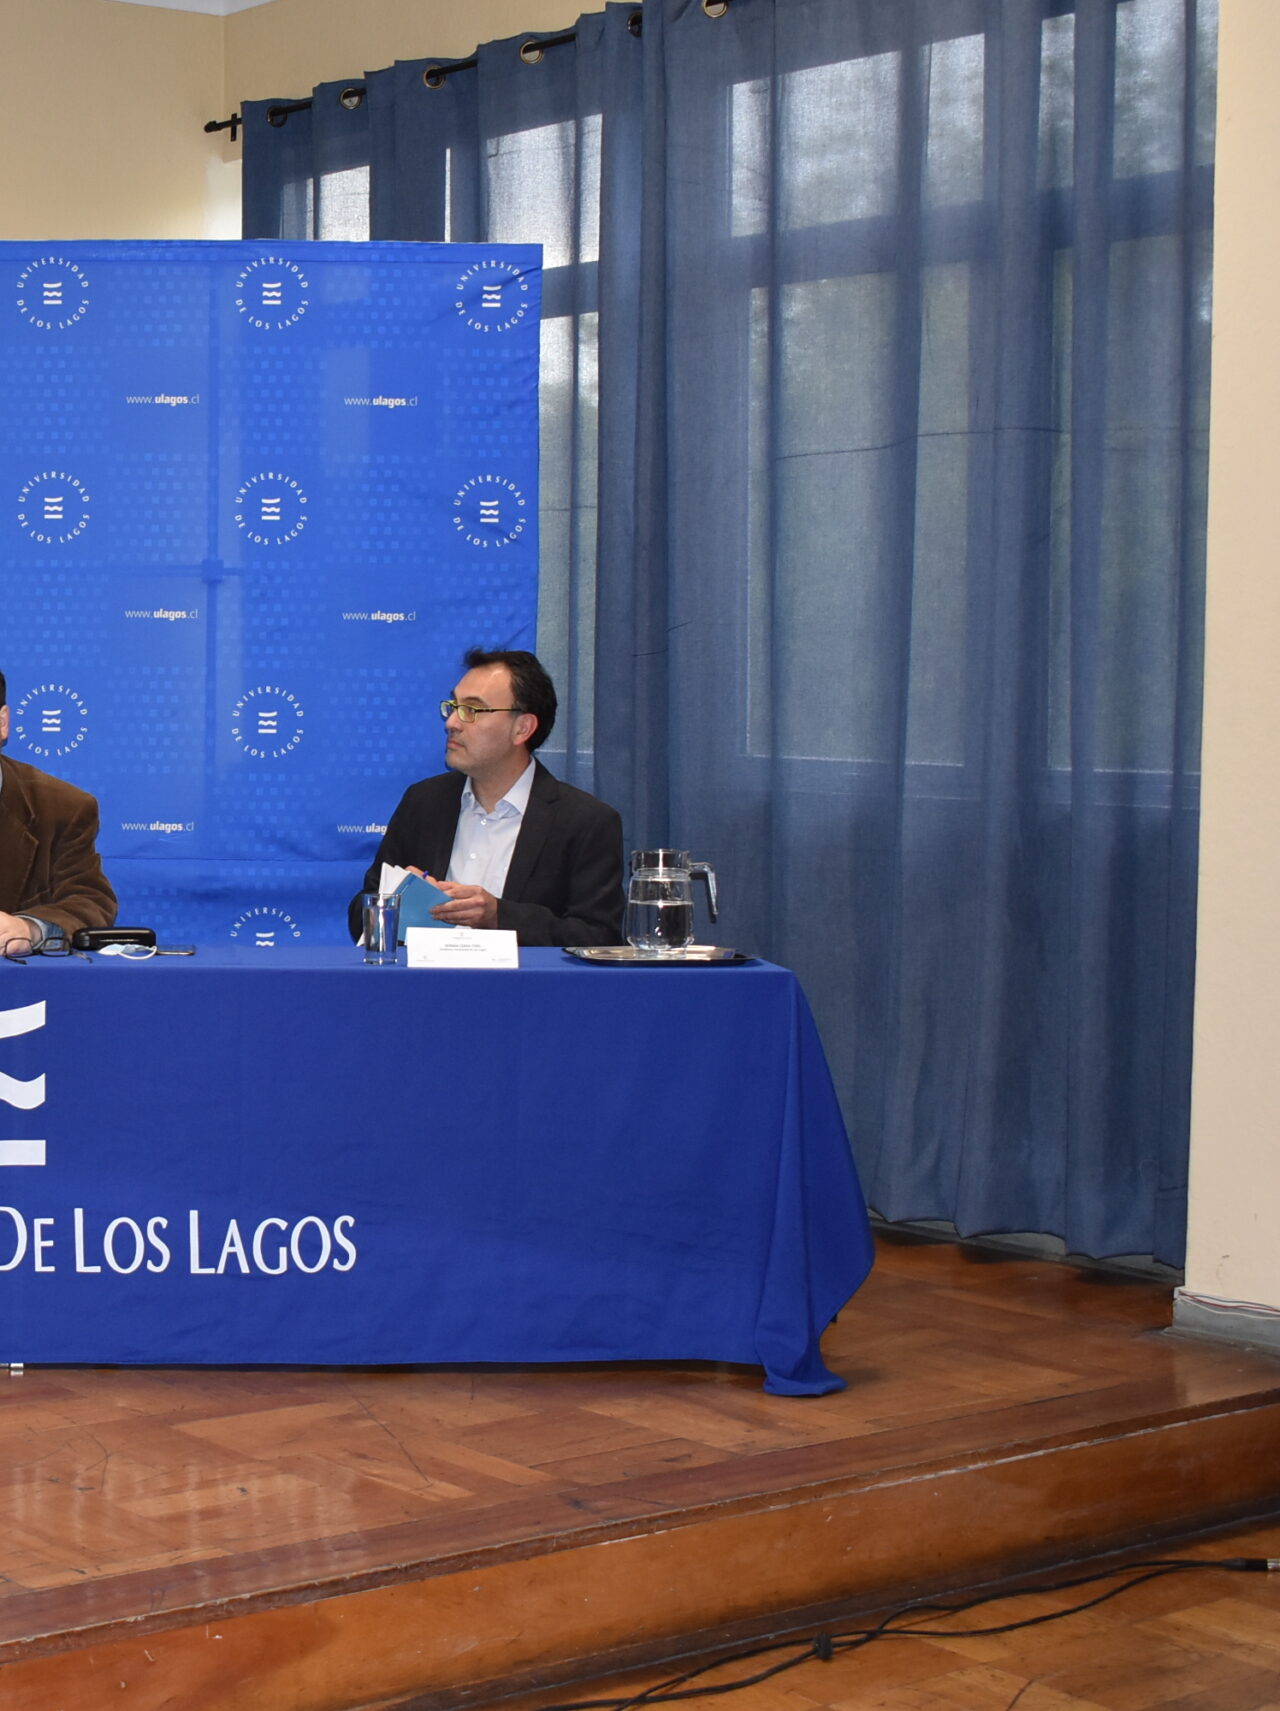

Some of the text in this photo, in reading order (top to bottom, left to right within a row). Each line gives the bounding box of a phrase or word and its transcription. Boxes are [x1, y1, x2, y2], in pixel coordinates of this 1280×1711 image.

[16, 255, 90, 289] UNIVERSIDAD
[234, 255, 310, 289] UNIVERSIDAD
[455, 259, 529, 292] UNIVERSIDAD
[15, 298, 90, 331] DE LOS LAGOS
[234, 298, 310, 331] DE LOS LAGOS
[454, 300, 529, 333] DE LOS LAGOS
[125, 392, 200, 408] www.ulagos.cl
[343, 394, 418, 409] www.ulagos.cl
[17, 470, 91, 503] UNIVERSIDAD
[234, 471, 308, 505] UNIVERSIDAD
[452, 473, 527, 507] UNIVERSIDAD
[16, 512, 91, 545] DE LOS LAGOS
[233, 513, 309, 546] DE LOS LAGOS
[452, 516, 527, 549] DE LOS LAGOS
[124, 607, 199, 622] www.ulagos.cl
[341, 609, 417, 624] www.ulagos.cl
[15, 683, 89, 716] UNIVERSIDAD
[231, 685, 305, 718] UNIVERSIDAD
[14, 725, 89, 757] DE LOS LAGOS
[230, 727, 305, 759] DE LOS LAGOS
[121, 820, 195, 835] www.ulagos.cl
[336, 822, 388, 836] www.ulag
[229, 906, 302, 938] UNIVERSIDAD
[74, 1207, 171, 1275] LOS
[189, 1209, 357, 1275] LAGOS
